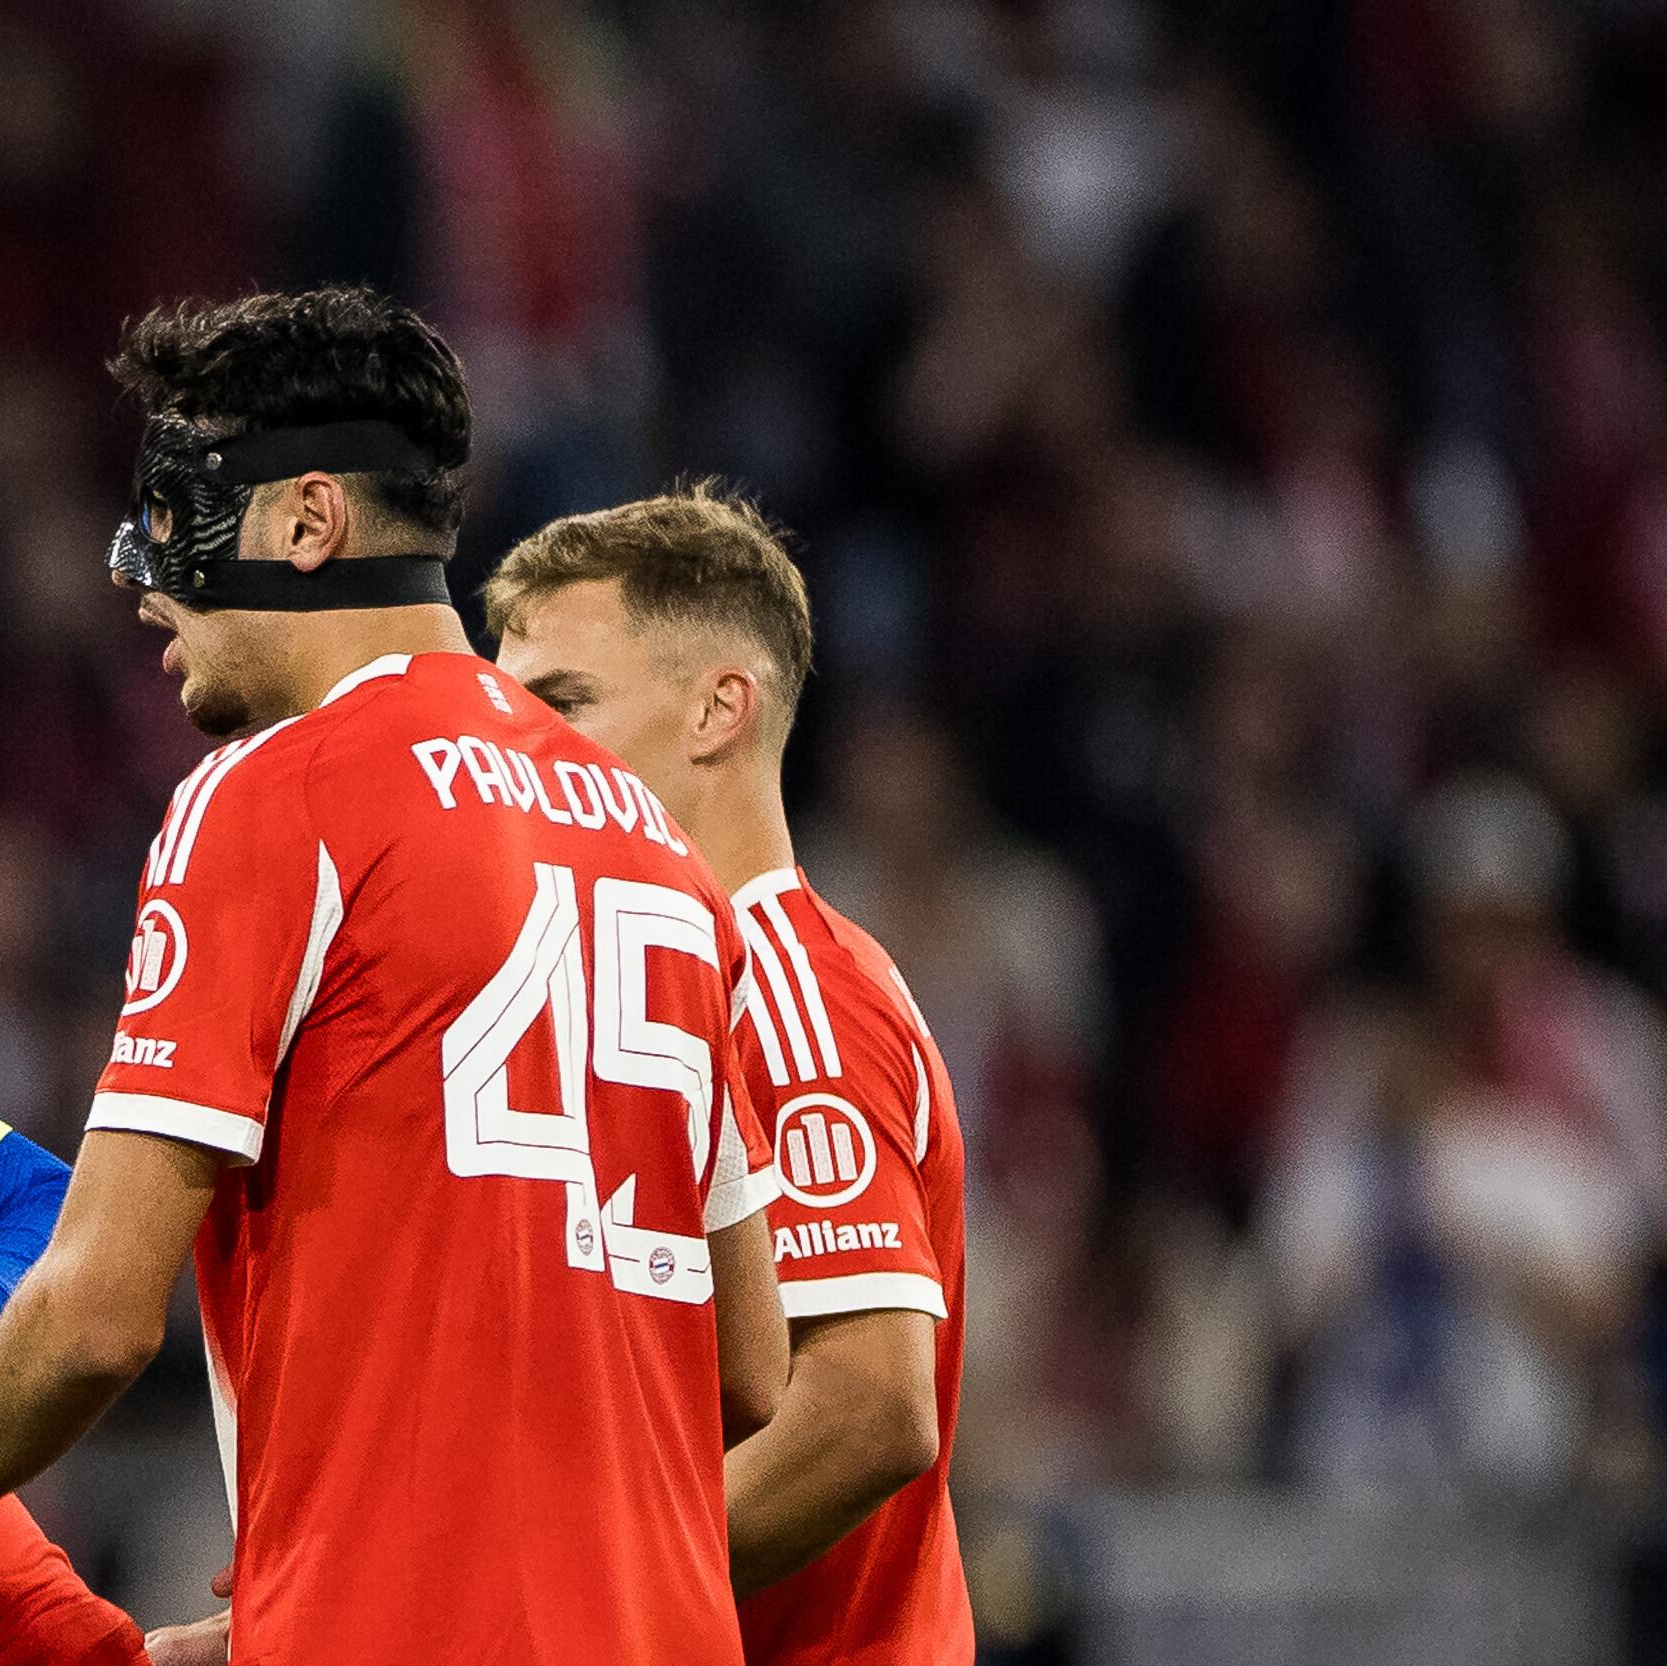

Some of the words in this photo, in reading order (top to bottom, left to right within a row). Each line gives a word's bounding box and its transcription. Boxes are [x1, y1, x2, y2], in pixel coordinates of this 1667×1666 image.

[110, 1030, 177, 1068] ianz
[442, 862, 719, 1304] 45
[774, 1220, 902, 1263] Allianz
